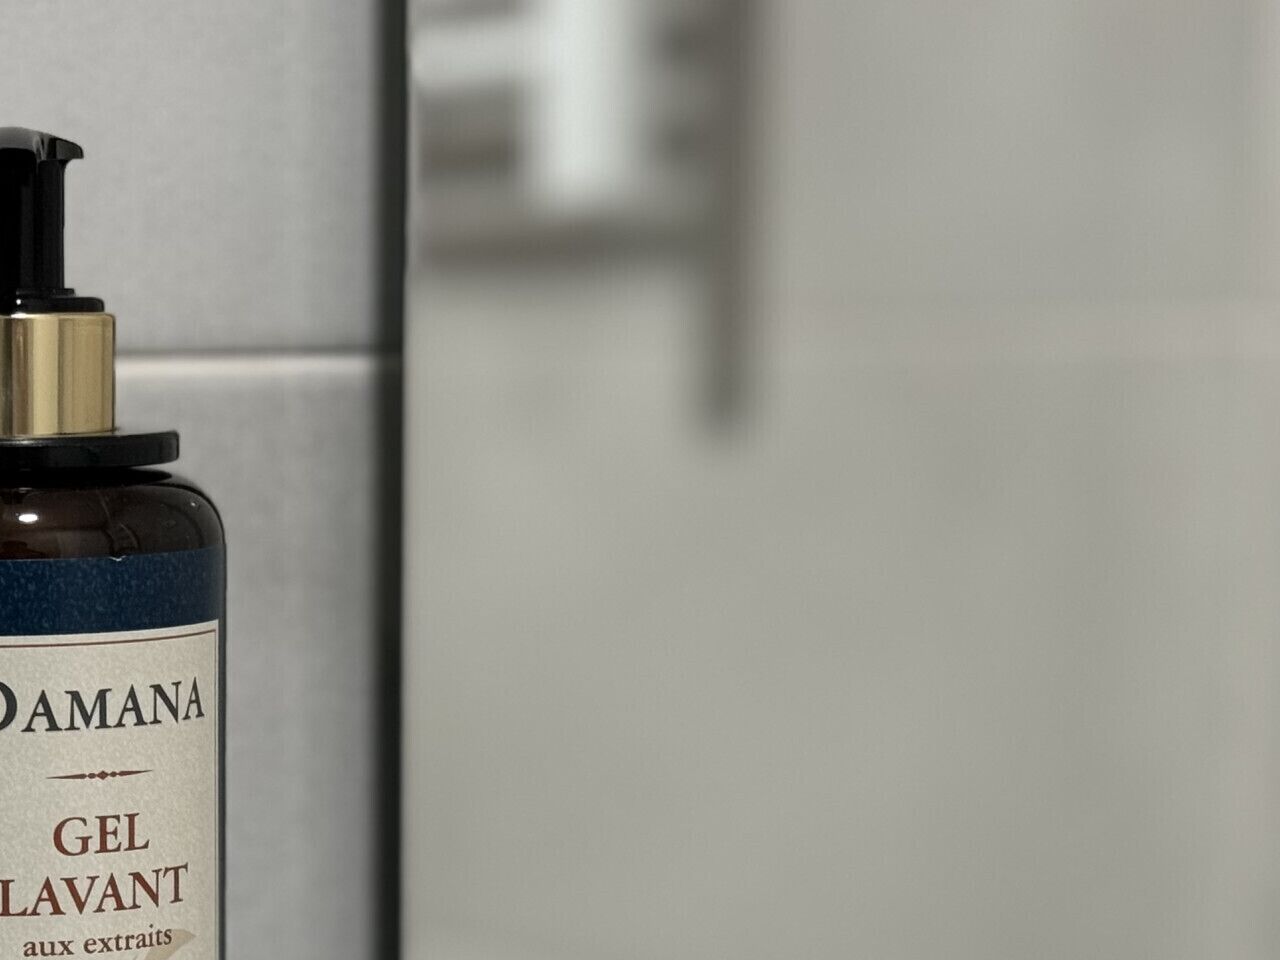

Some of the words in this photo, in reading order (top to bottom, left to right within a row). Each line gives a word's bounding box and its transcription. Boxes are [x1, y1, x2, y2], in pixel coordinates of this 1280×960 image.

[53, 813, 150, 856] GEL
[23, 939, 74, 957] aux
[83, 924, 173, 954] extraits
